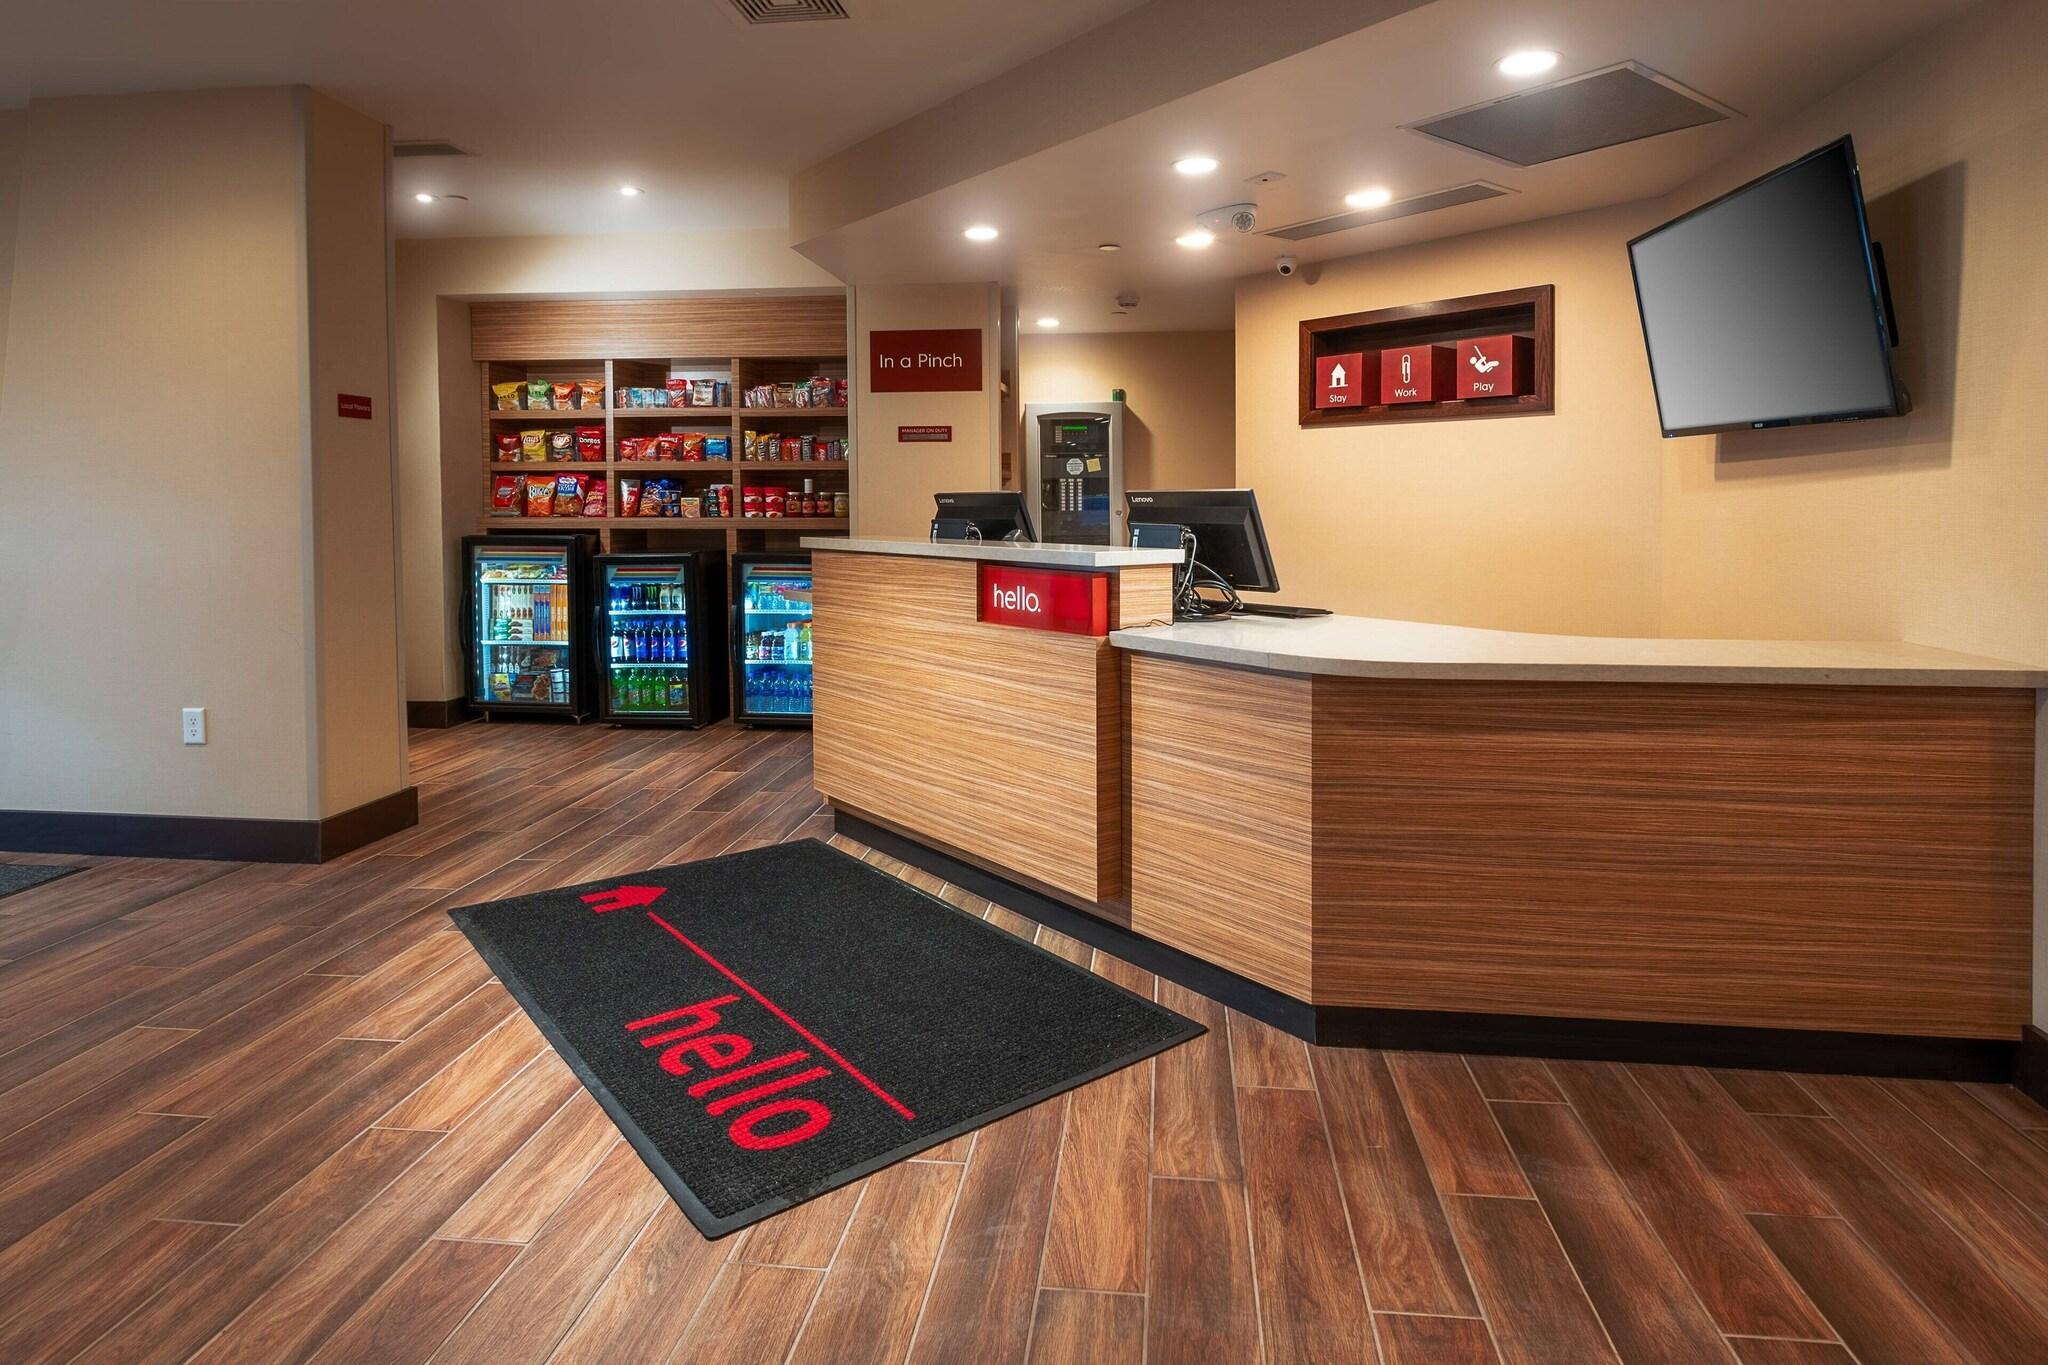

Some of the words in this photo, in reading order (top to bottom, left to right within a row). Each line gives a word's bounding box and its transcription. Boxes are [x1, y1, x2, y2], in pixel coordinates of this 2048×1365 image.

[880, 354, 894, 369] In
[900, 357, 911, 368] a
[918, 353, 962, 368] Pinch
[1394, 387, 1418, 398] Work
[1473, 381, 1495, 393] Play
[1329, 394, 1347, 404] Stay
[624, 993, 833, 1151] hello
